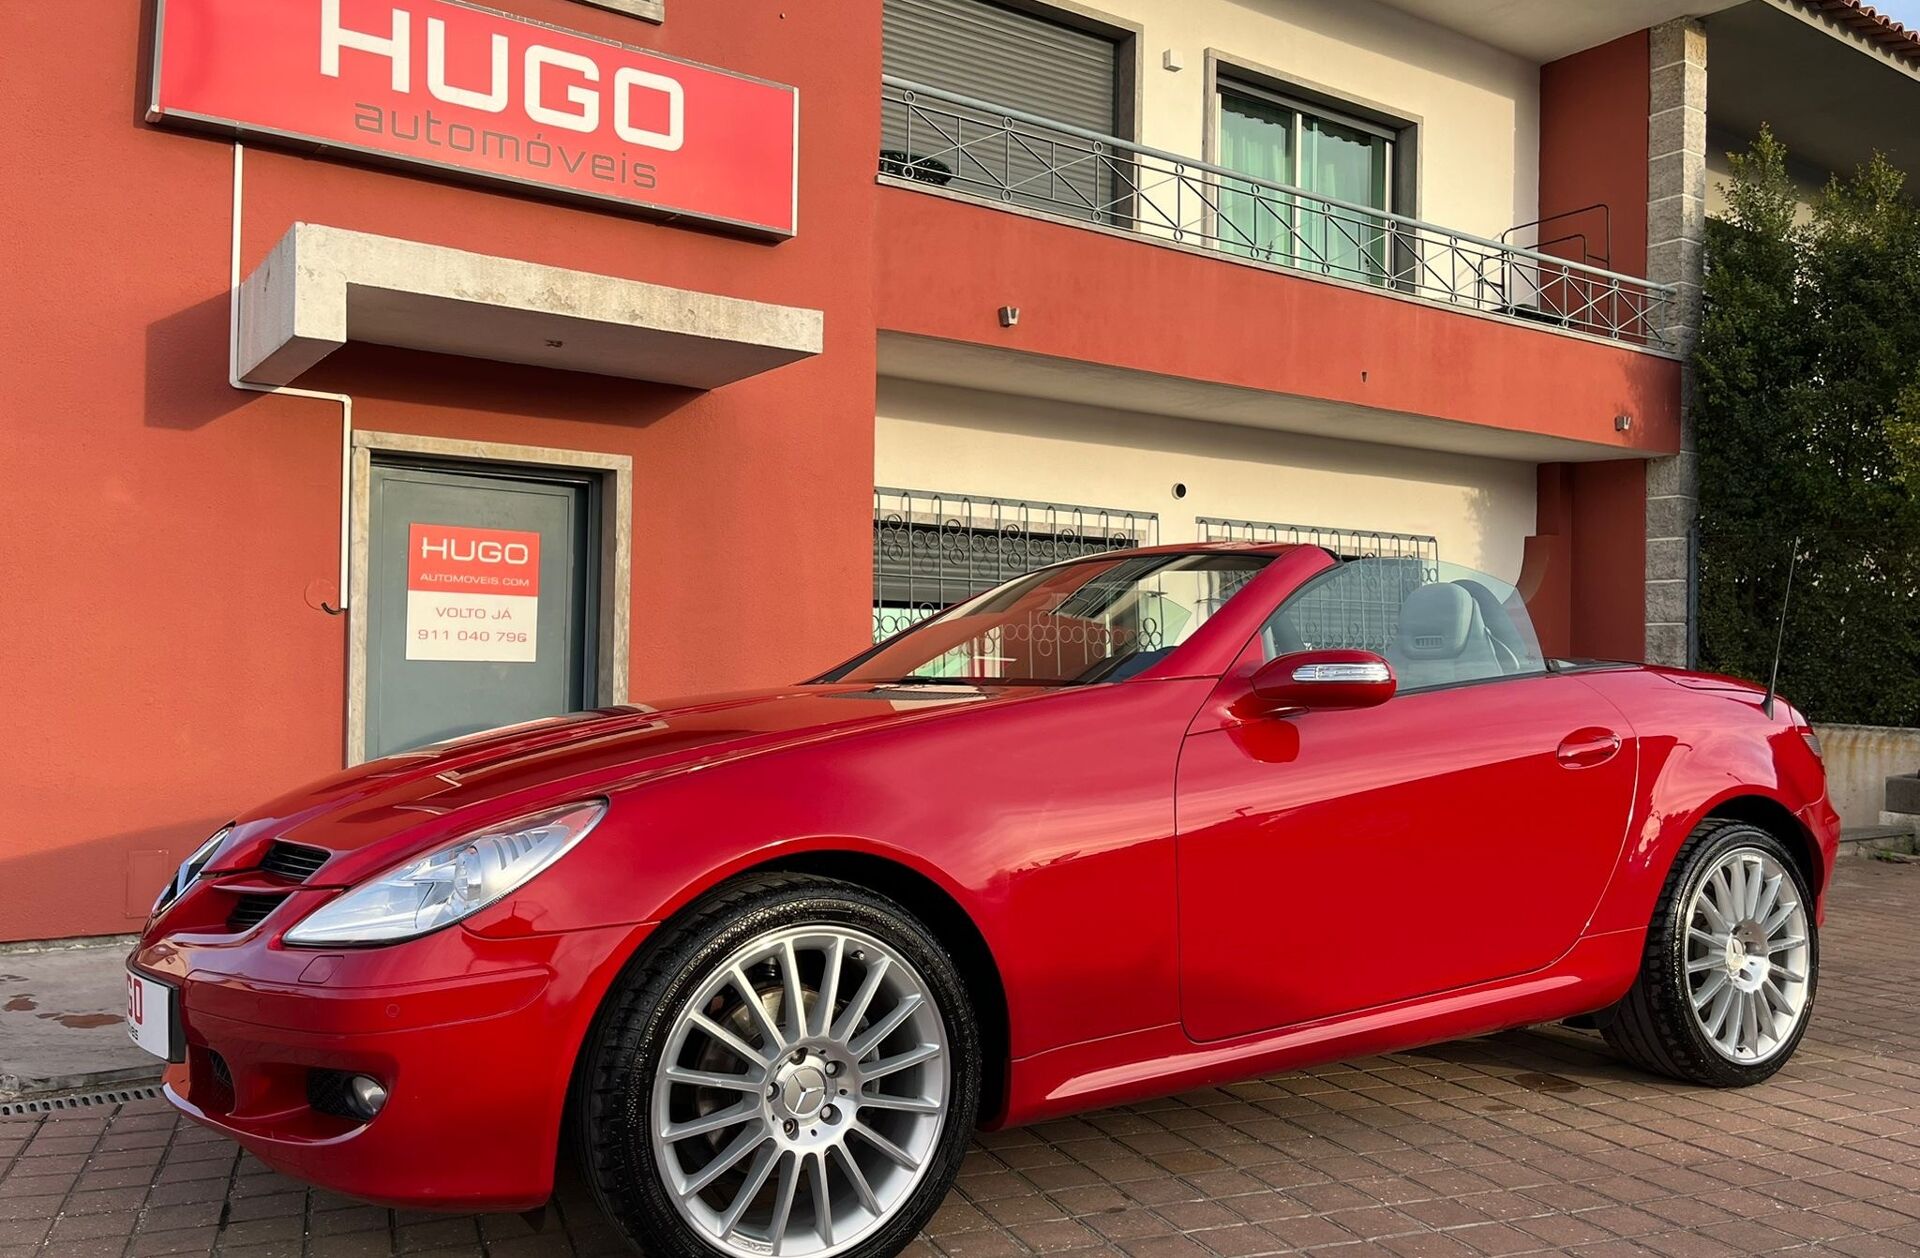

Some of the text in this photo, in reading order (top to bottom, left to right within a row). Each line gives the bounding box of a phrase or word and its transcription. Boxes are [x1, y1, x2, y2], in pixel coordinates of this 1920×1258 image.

[320, 0, 685, 152] HUGO
[354, 102, 657, 189] automóveis
[421, 536, 529, 565] HUGO
[435, 607, 486, 620] VOLTO
[418, 629, 528, 643] 911 040 796
